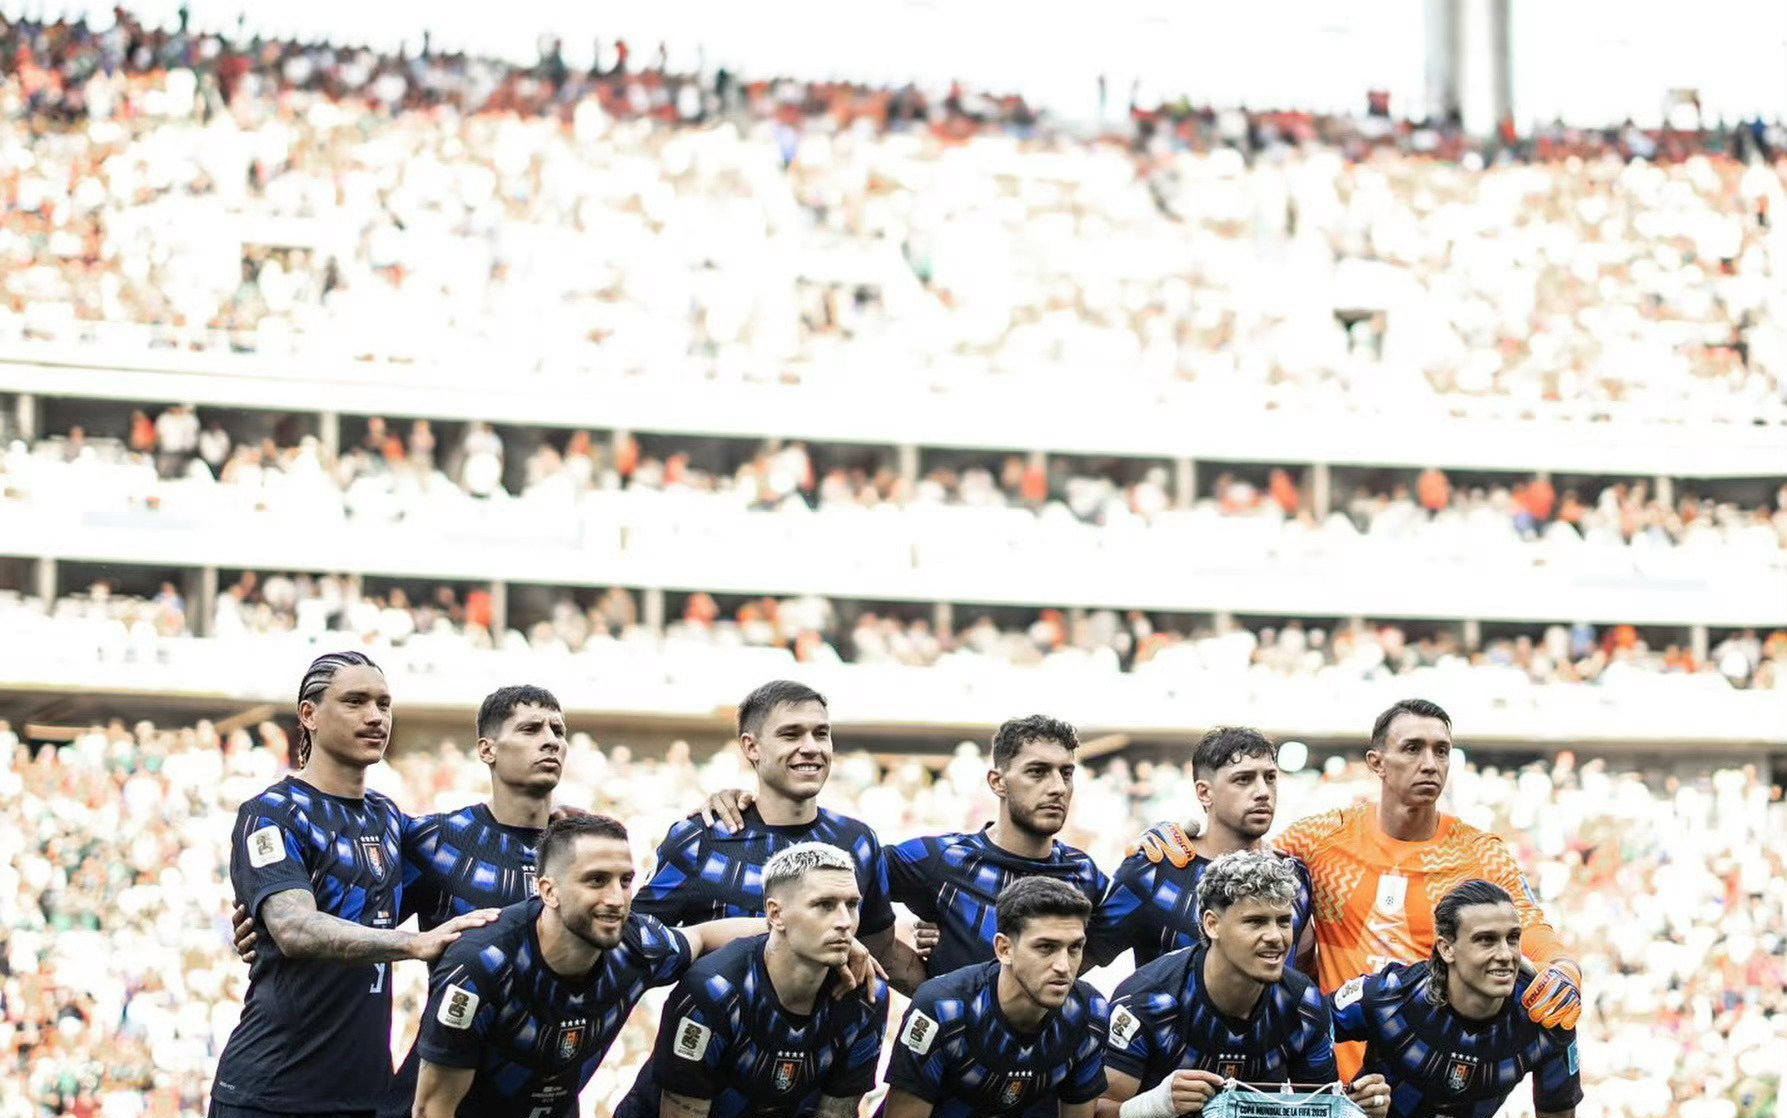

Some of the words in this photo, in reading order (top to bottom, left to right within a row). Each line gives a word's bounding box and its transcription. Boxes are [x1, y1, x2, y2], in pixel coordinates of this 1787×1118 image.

[1240, 1105, 1255, 1115] COPA
[1256, 1106, 1281, 1116] MUNDIAL
[1283, 1107, 1290, 1117] DE
[1291, 1107, 1298, 1117] LA
[1299, 1107, 1310, 1117] FIFA
[1311, 1108, 1328, 1118] 2026
